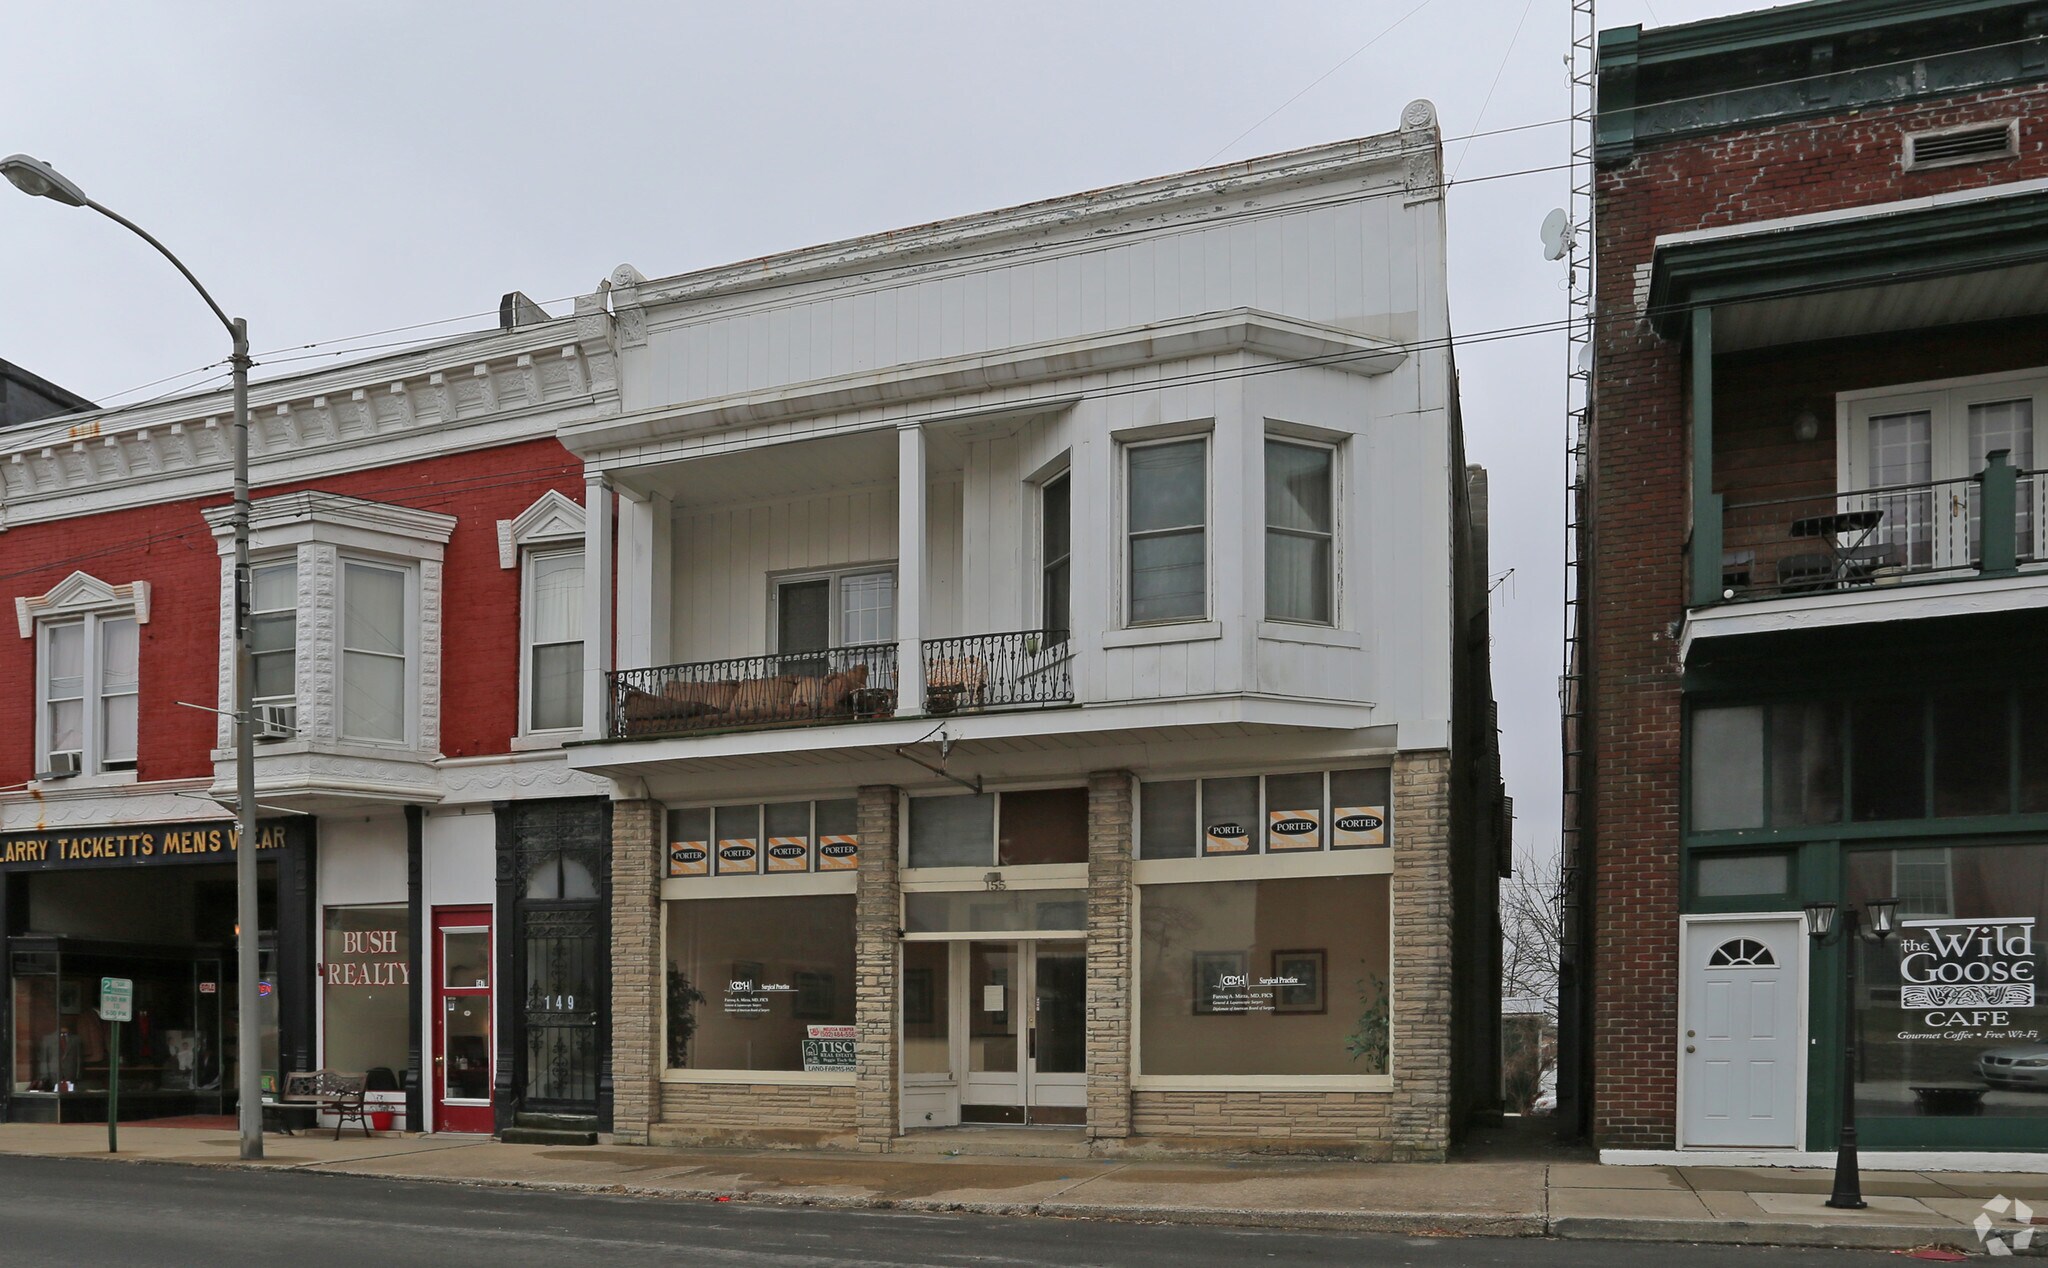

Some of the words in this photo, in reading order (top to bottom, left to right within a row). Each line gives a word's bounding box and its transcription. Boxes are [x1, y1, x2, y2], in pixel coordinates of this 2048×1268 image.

[1276, 822, 1312, 832] PORTER
[1340, 819, 1378, 828] PORTER
[58, 832, 153, 859] TACKETT'S
[163, 830, 221, 854] MENS
[825, 846, 855, 854] PORTER
[675, 852, 702, 860] PORTER
[773, 848, 802, 856] PORTER
[986, 880, 1007, 891] 155
[343, 930, 398, 954] BUSH
[1901, 939, 1930, 953] the
[1924, 925, 2036, 957] Wild
[328, 962, 409, 986] REALTY
[1259, 976, 1278, 985] Surgical
[1279, 976, 1298, 984] Practice
[544, 994, 574, 1010] 149
[1924, 1011, 2010, 1027] CAFE
[1897, 1031, 1941, 1040] Gourmet
[1943, 1030, 1974, 1042] Coffee
[1984, 1030, 2005, 1039] Free
[2008, 1030, 2038, 1038] Wi-Fi
